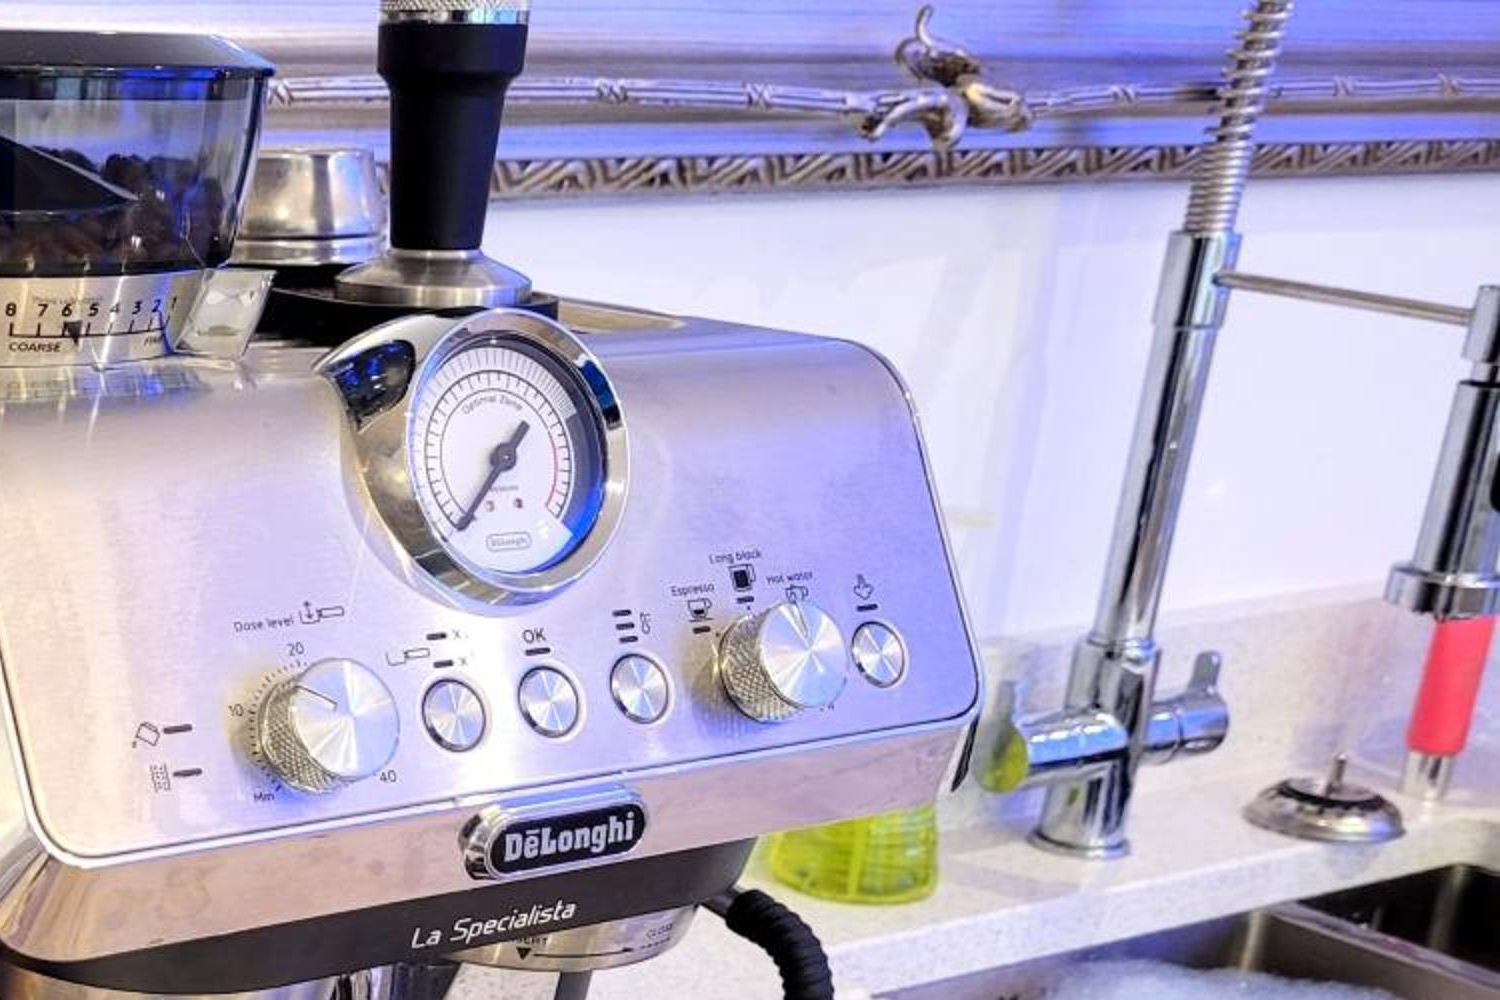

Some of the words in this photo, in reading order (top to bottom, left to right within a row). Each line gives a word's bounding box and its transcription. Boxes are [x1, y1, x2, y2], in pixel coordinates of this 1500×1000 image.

[5, 302, 17, 317] 8
[37, 302, 49, 317] 7
[61, 302, 73, 317] 6
[87, 302, 99, 317] 5
[109, 301, 121, 314] 4
[131, 300, 142, 315] 3
[151, 299, 162, 313] 2
[8, 342, 62, 353] COARSE
[708, 552, 735, 565] Long
[735, 549, 762, 561] black
[670, 583, 716, 598] Espresso
[233, 620, 264, 633] Dose
[264, 614, 296, 629] level
[521, 628, 548, 644] OK
[286, 641, 305, 657] 20
[229, 702, 245, 718] 10
[378, 769, 398, 784] 40
[410, 927, 442, 950] La
[450, 900, 577, 945] Specialista
